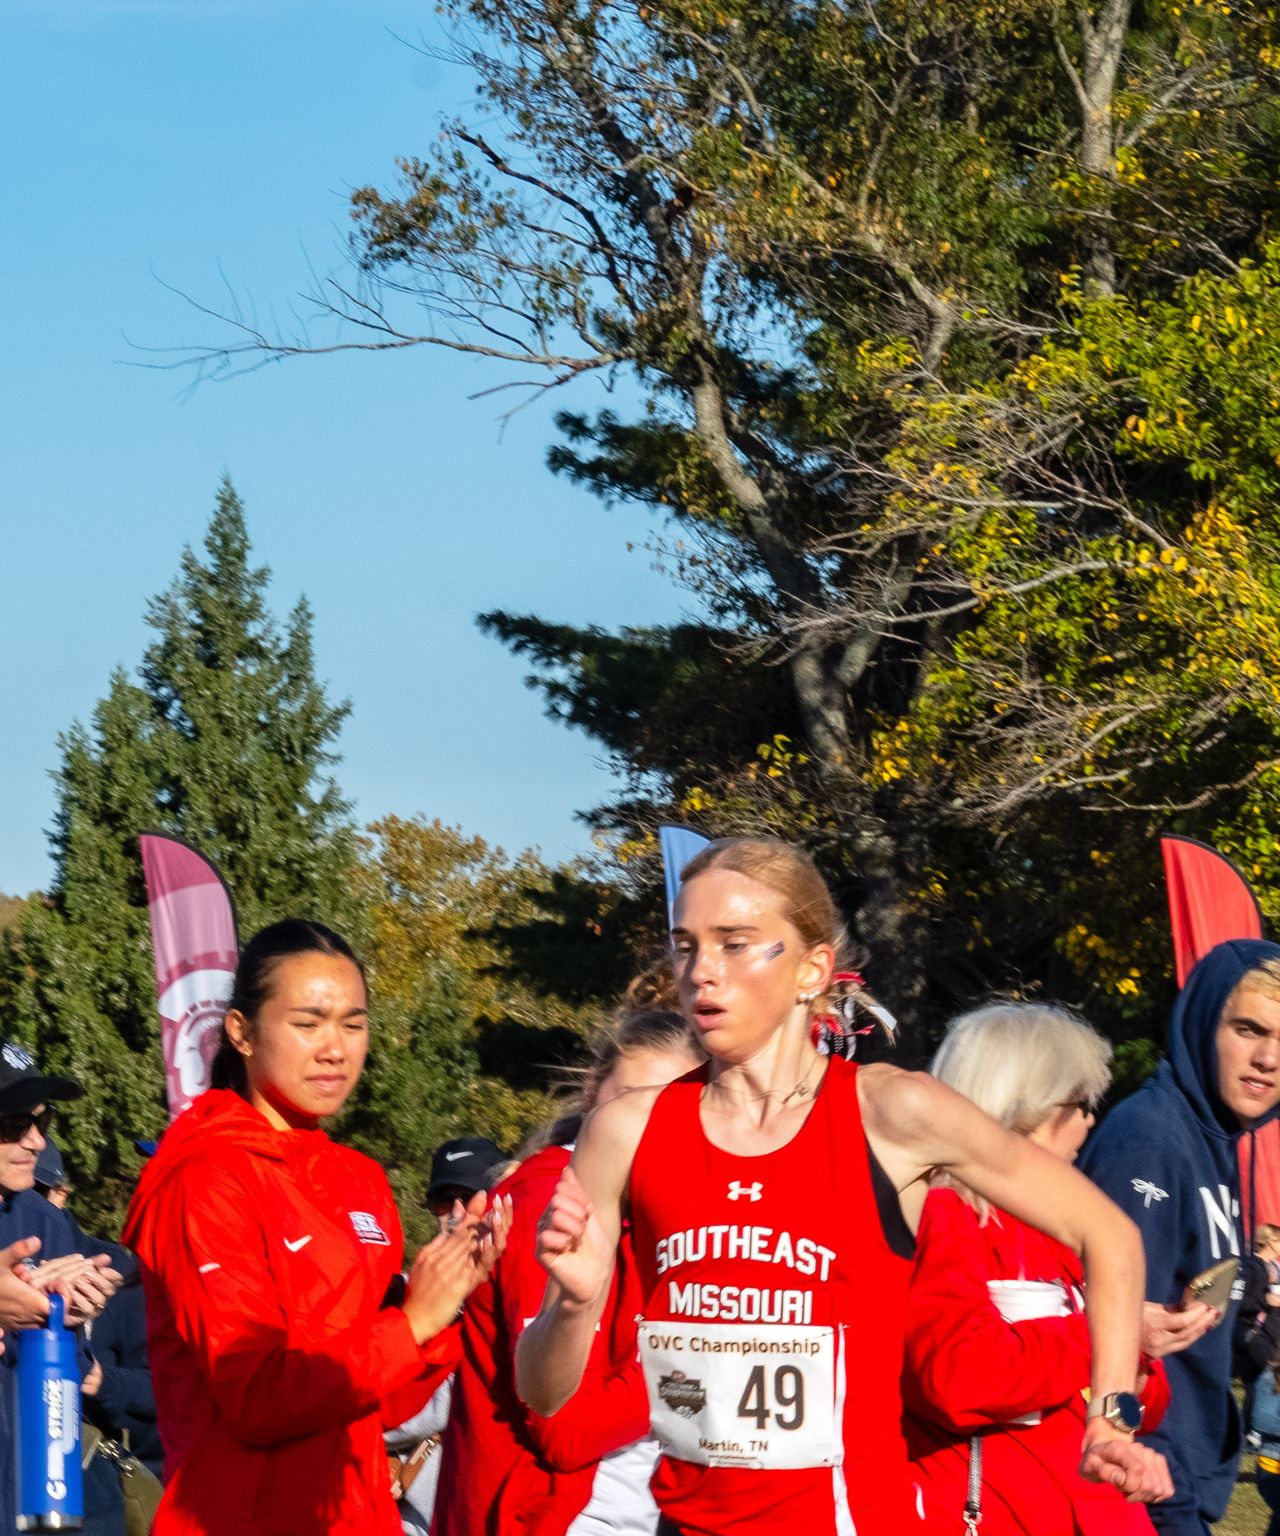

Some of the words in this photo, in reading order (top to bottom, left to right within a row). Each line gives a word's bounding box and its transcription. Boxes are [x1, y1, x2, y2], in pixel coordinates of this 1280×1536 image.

[656, 1224, 837, 1283] SOUTHEAST
[668, 1280, 813, 1325] MISSOURI
[648, 1333, 684, 1352] OVC
[689, 1338, 820, 1357] Championship
[737, 1365, 804, 1431] 49
[698, 1438, 743, 1453] Martin,
[749, 1440, 768, 1451] TN
